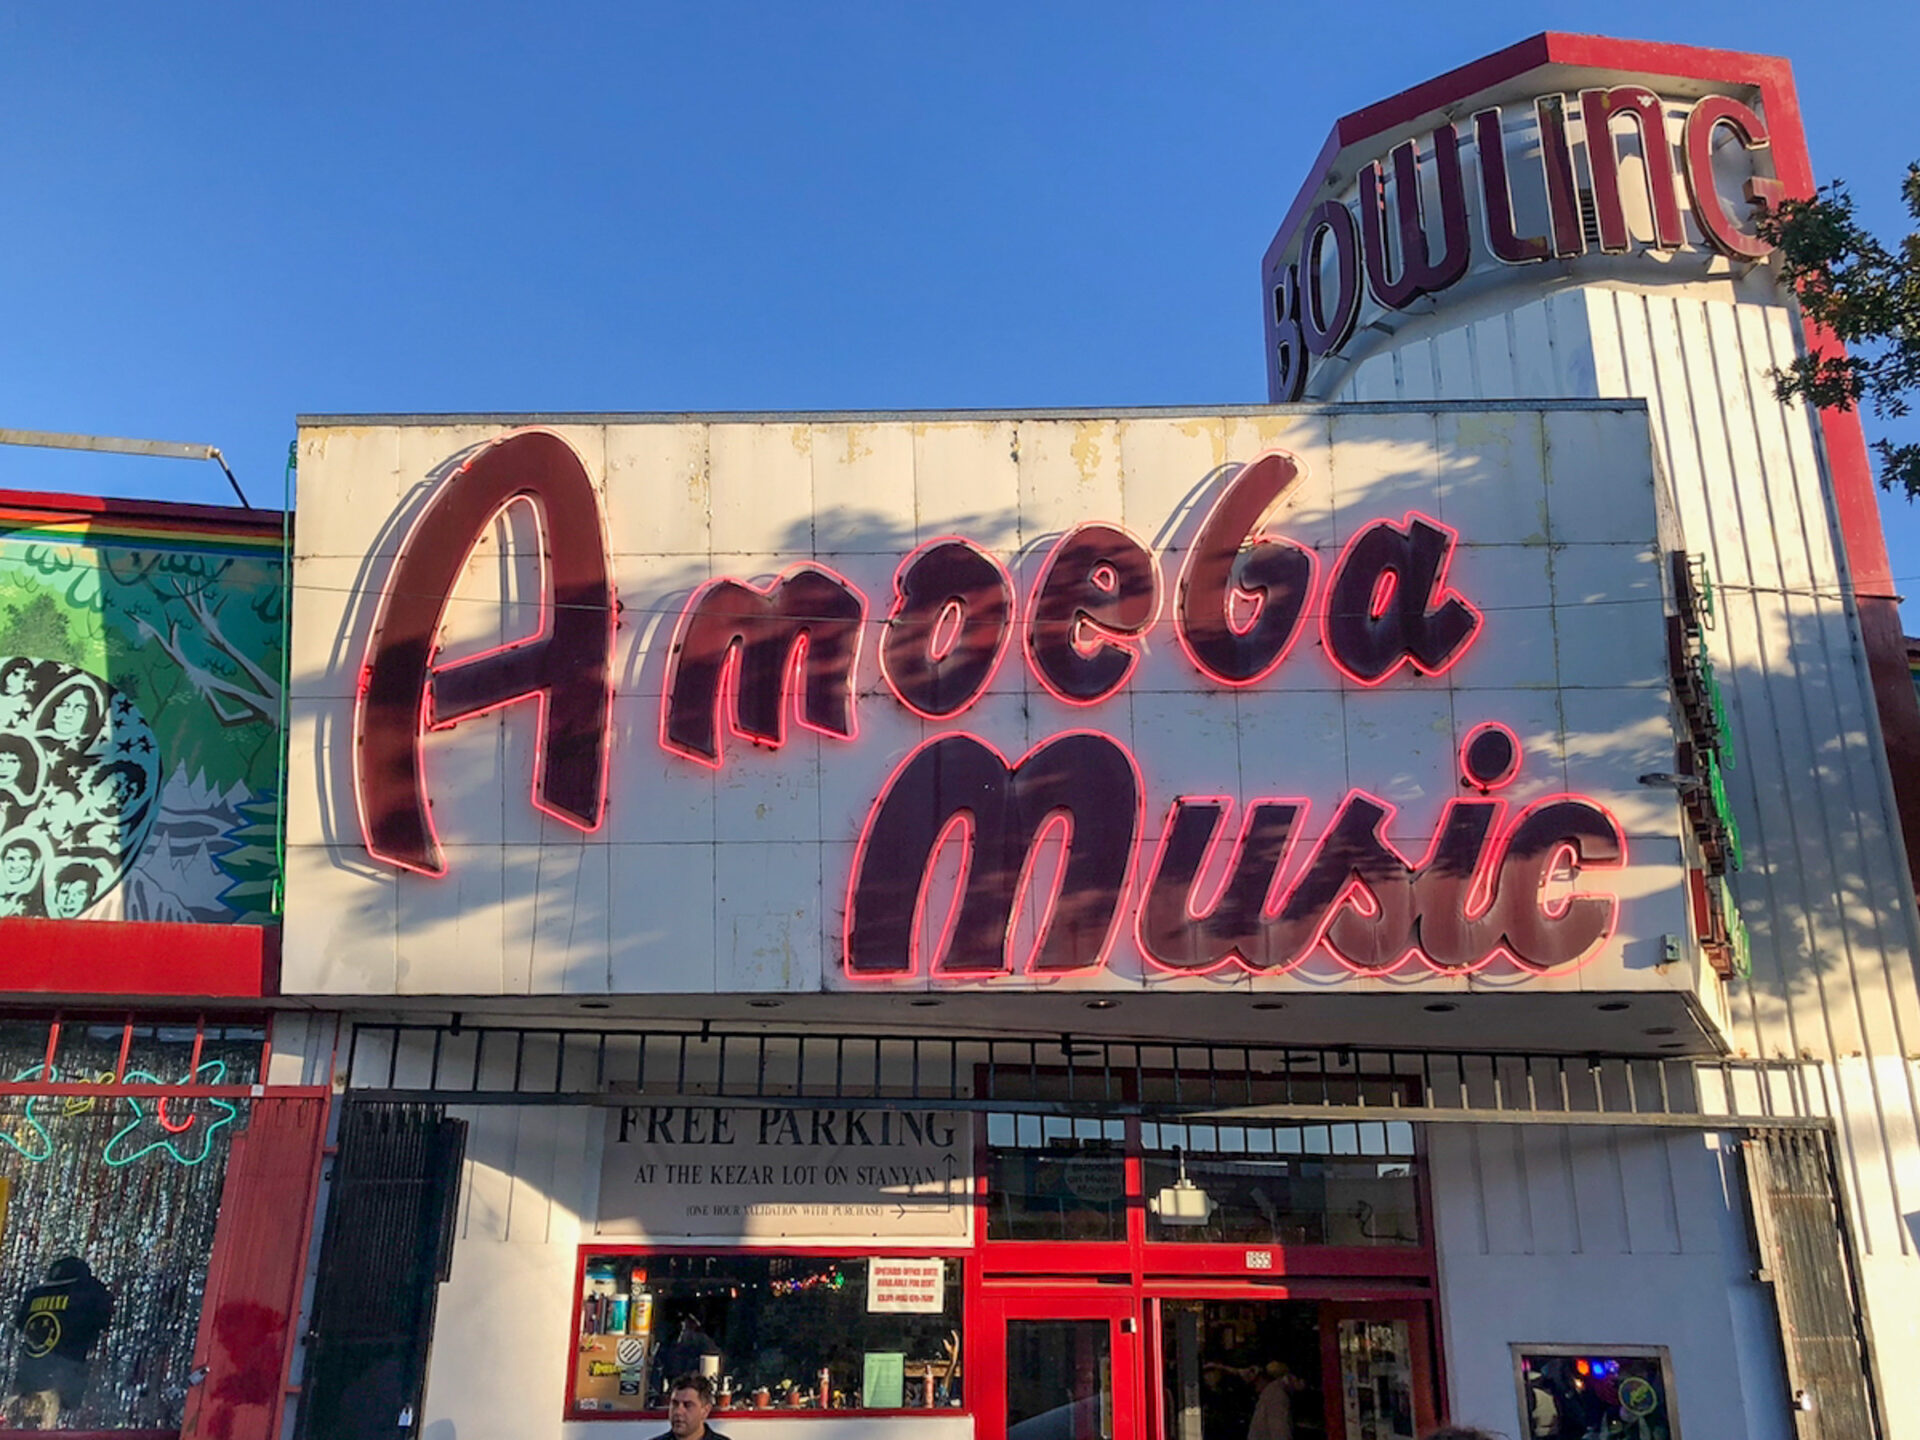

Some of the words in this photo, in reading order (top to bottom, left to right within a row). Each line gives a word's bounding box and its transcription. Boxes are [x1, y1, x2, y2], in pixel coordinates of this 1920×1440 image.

[1264, 84, 1785, 401] BOWLING
[355, 427, 1485, 877] Amoeba
[843, 722, 1629, 979] Music
[616, 1107, 736, 1145] FREE
[756, 1109, 956, 1148] PARKING
[634, 1164, 657, 1184] AT
[666, 1165, 702, 1185] THE
[711, 1165, 774, 1186] KEZAR
[783, 1165, 818, 1186] LOT
[825, 1165, 849, 1186] ON
[857, 1165, 936, 1188] STANYAN
[713, 1204, 740, 1217] HOUR
[745, 1204, 798, 1217] VALIDATION
[803, 1205, 829, 1217] WITH
[1248, 1252, 1272, 1267] 1855
